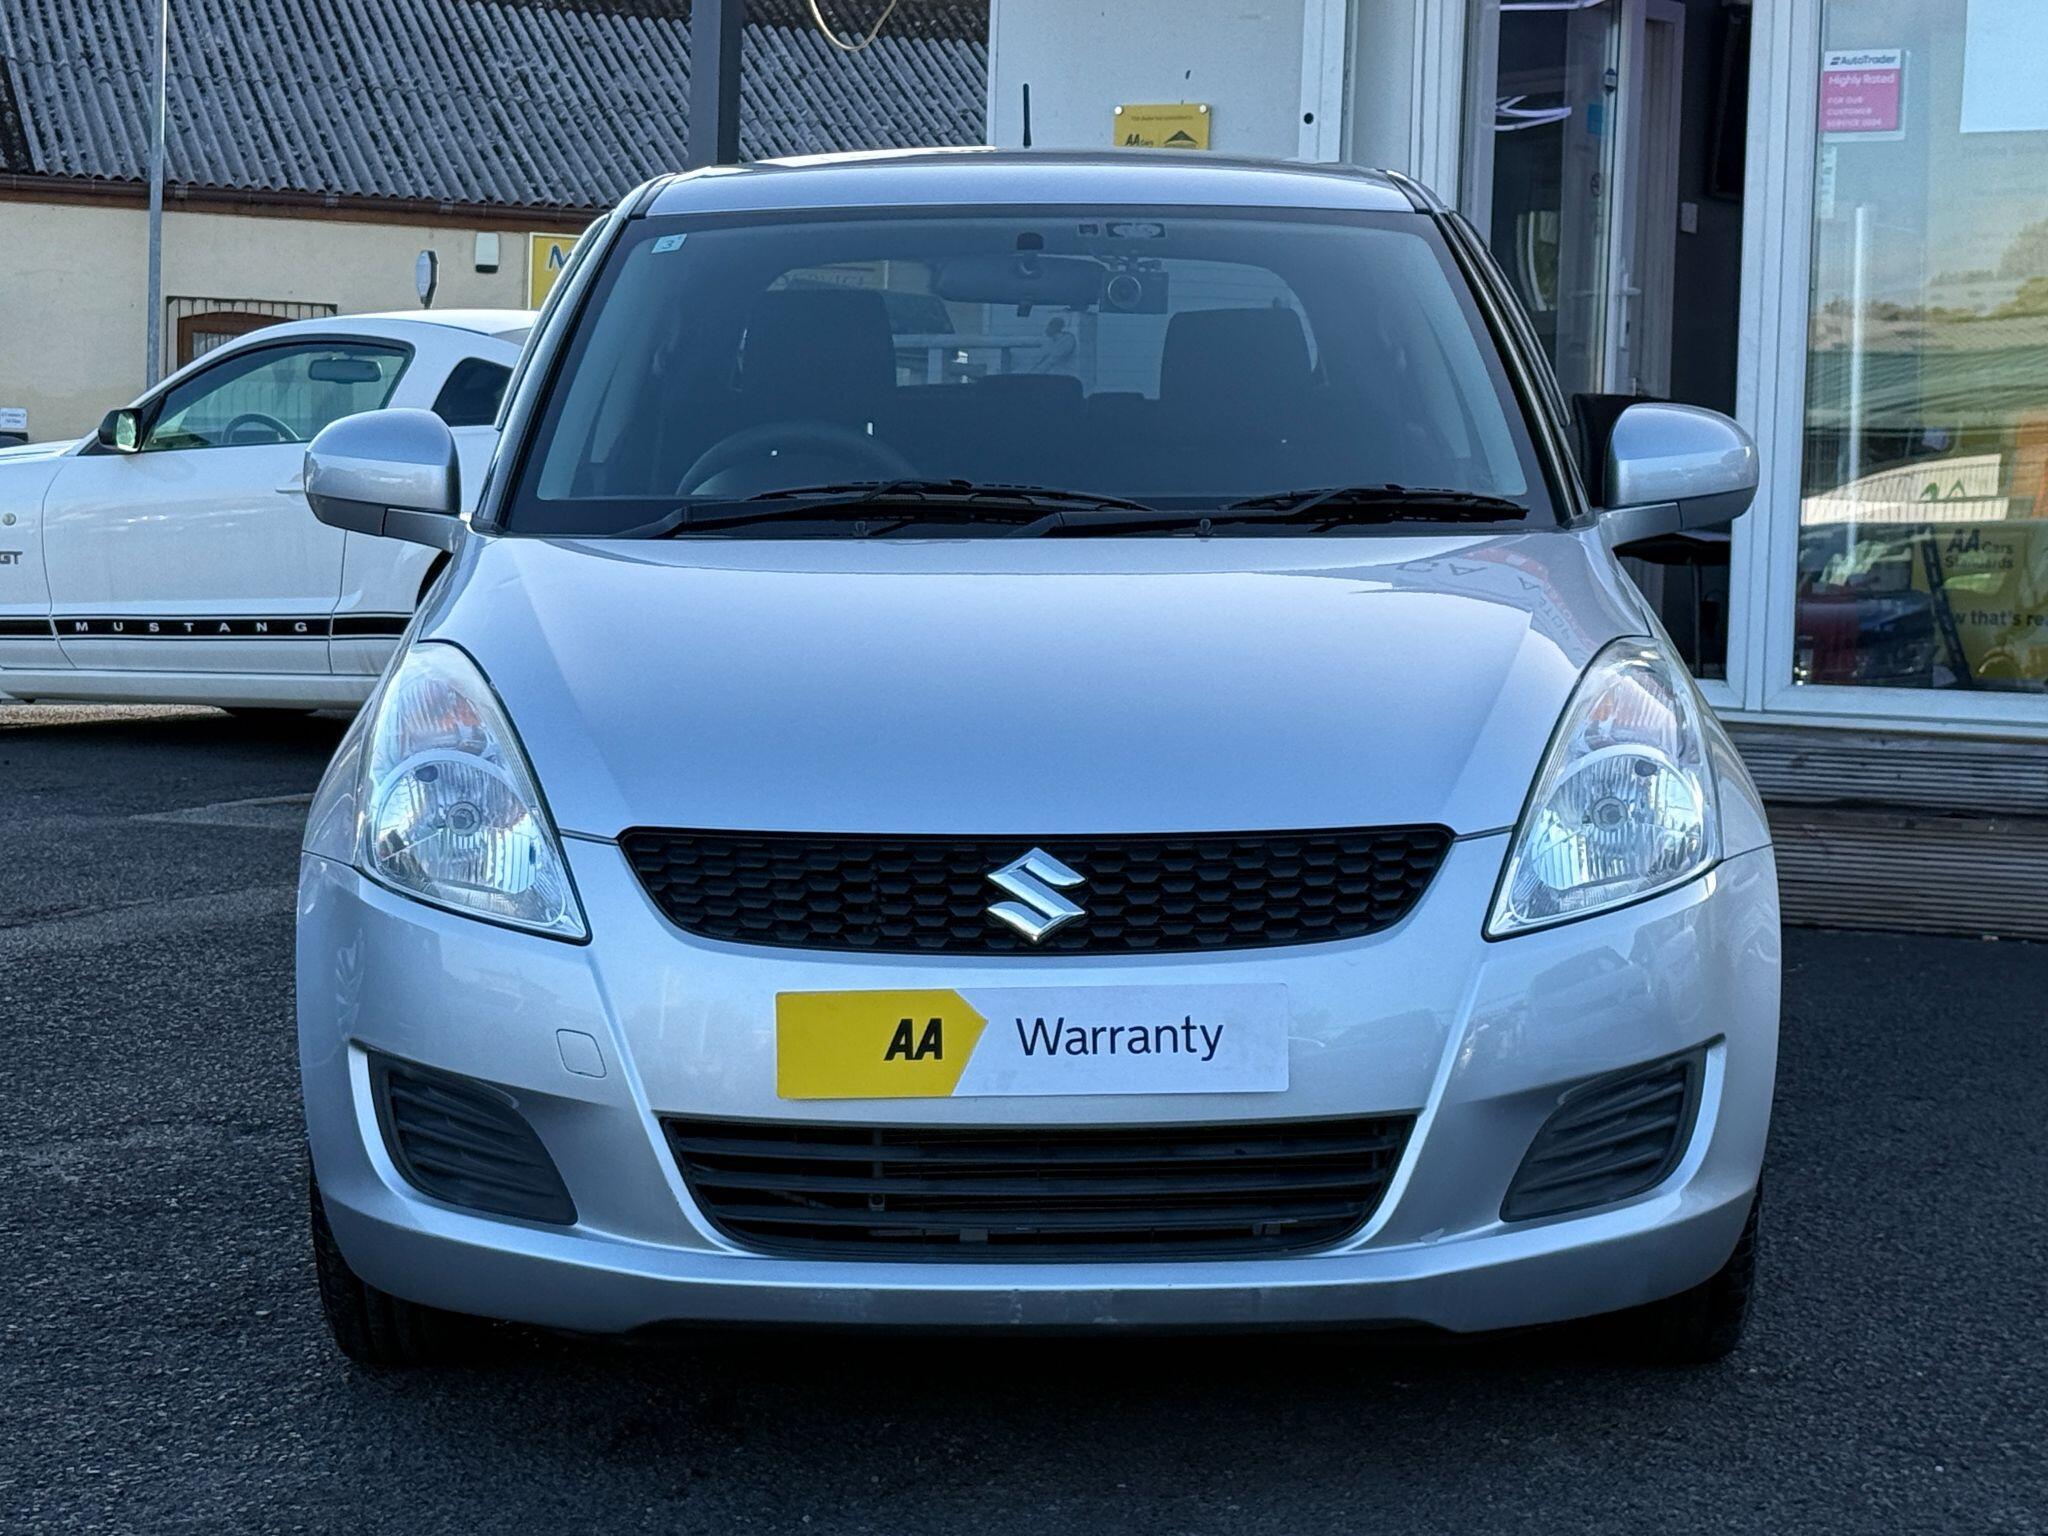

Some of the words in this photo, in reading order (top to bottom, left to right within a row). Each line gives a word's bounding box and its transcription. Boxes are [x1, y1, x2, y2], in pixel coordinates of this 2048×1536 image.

[1840, 55, 1896, 65] AutoTrader
[1829, 74, 1861, 88] Highly
[1863, 73, 1895, 85] Rated
[1946, 528, 1981, 553] AA
[1970, 609, 2022, 627] that's
[75, 621, 308, 633] MUSTANG
[884, 1018, 943, 1061] AA
[1015, 1014, 1224, 1062] Warranty
